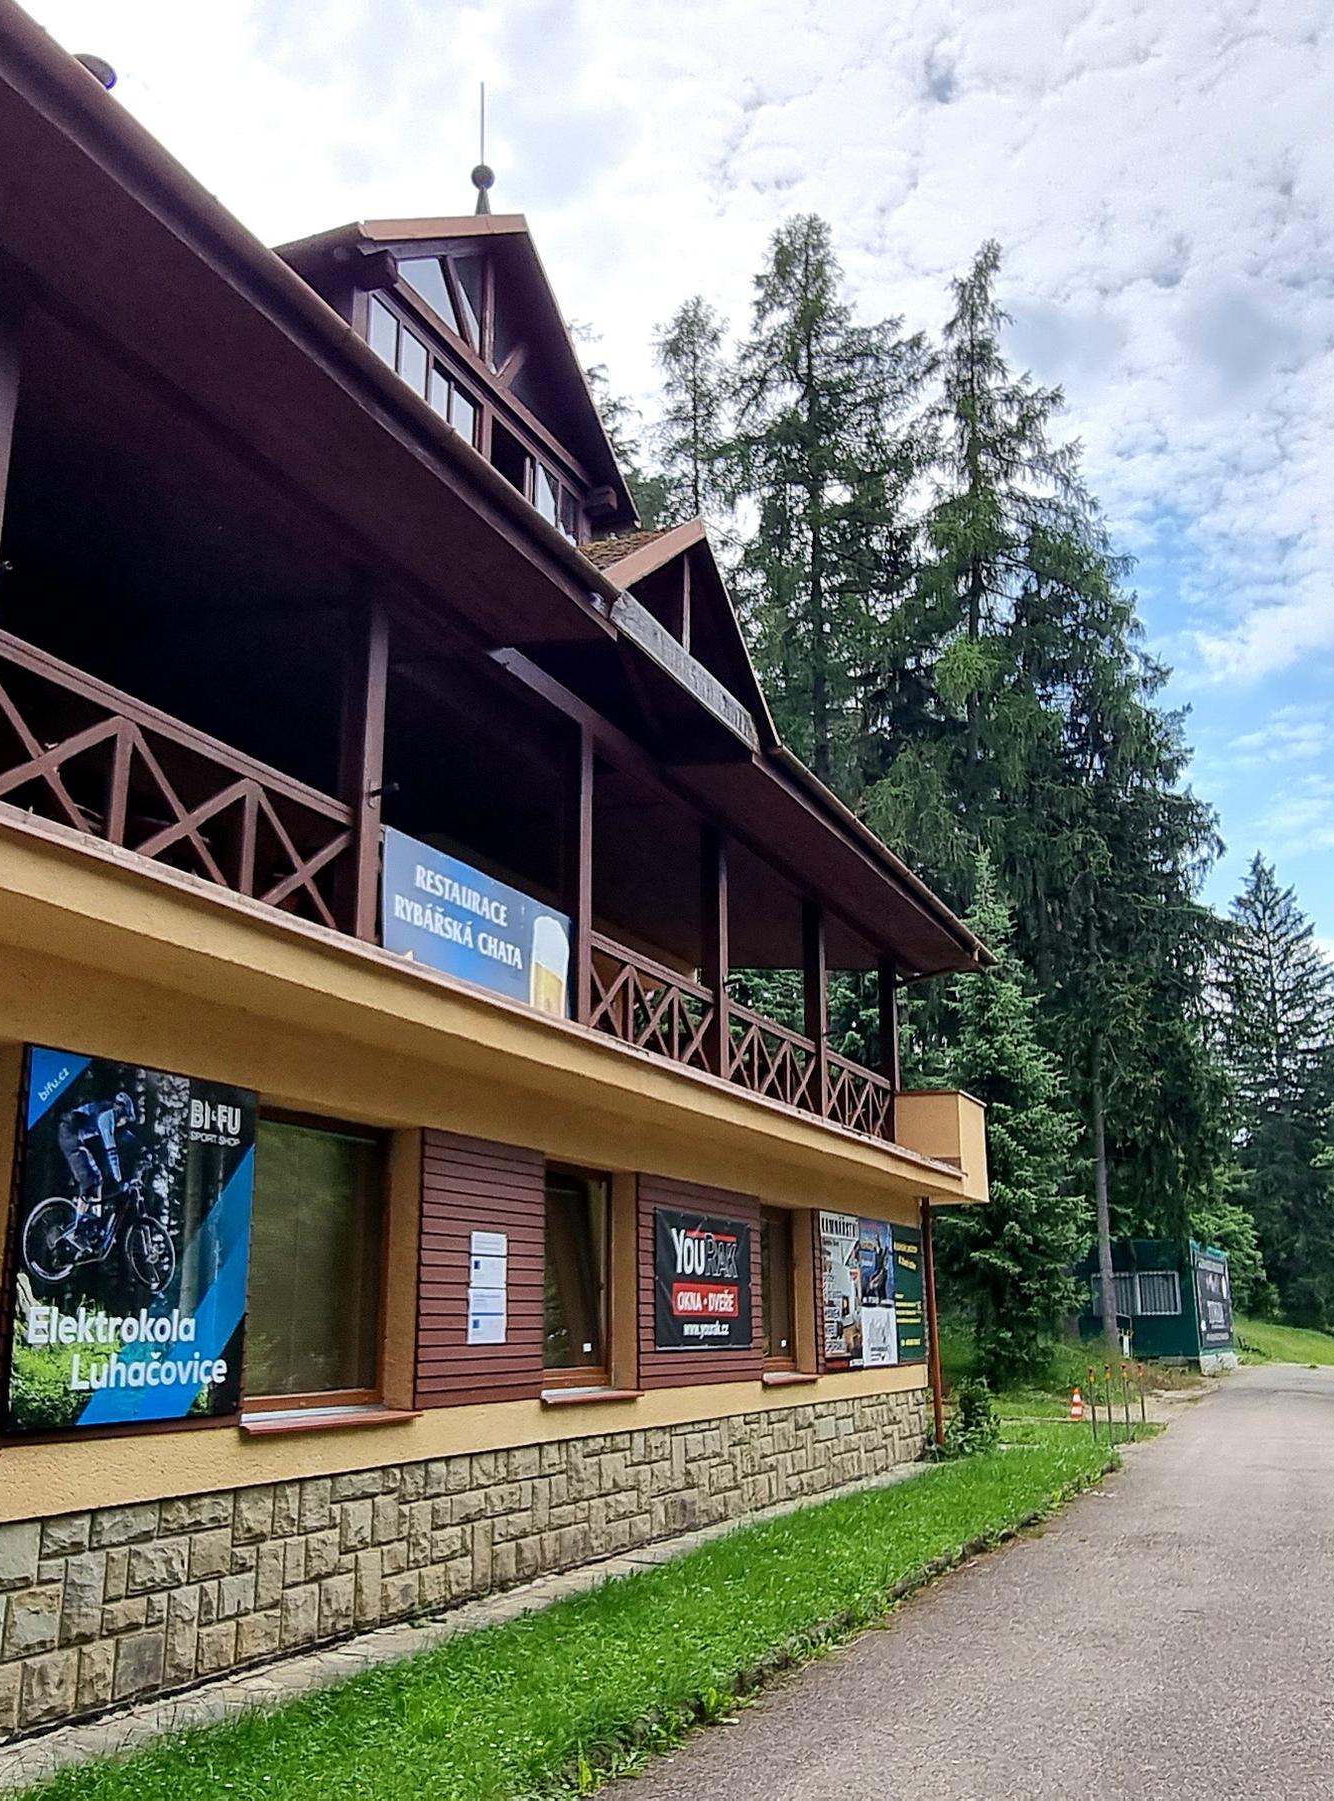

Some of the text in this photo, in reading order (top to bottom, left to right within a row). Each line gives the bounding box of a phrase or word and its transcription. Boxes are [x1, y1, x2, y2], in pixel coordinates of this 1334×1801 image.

[415, 864, 509, 928] RESTAURACE
[394, 894, 524, 971] RYBÁŘSKÁ CHATA
[37, 1067, 70, 1102] bifu.cz
[190, 1130, 242, 1147] SPORT SHOP
[677, 1289, 735, 1313] OKNA DVEŘE
[27, 1305, 196, 1345] Elektrokola
[71, 1351, 228, 1391] Luhačovice
